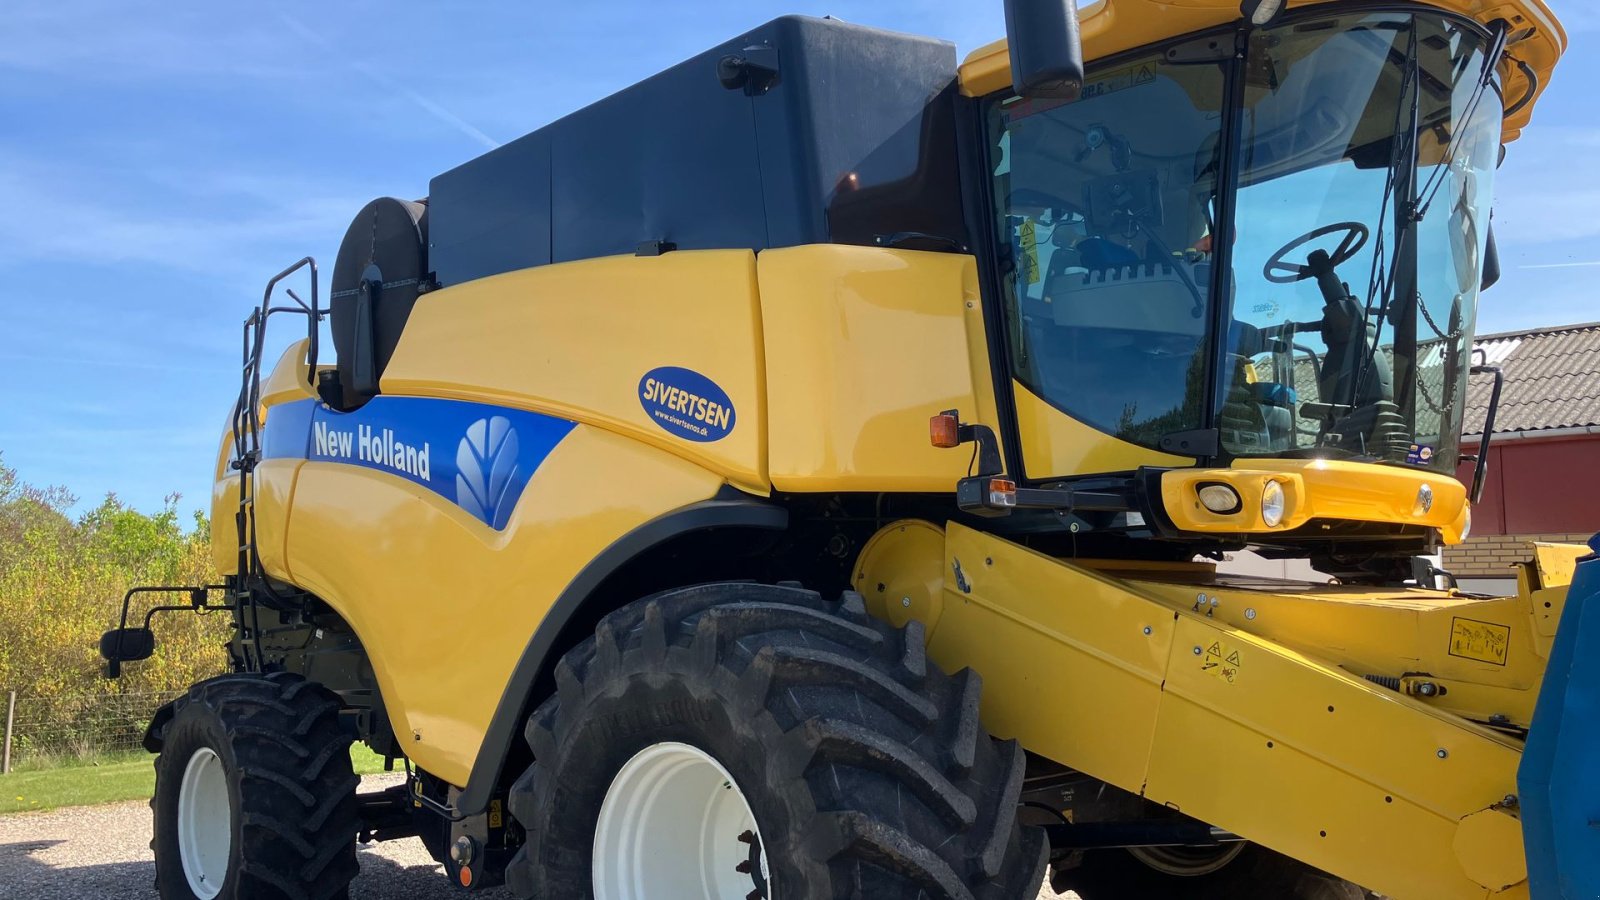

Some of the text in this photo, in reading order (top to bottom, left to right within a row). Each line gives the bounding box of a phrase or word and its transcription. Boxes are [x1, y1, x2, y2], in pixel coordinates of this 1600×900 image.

[643, 378, 730, 430] SIVERTSEN
[315, 421, 430, 481] New Holland
